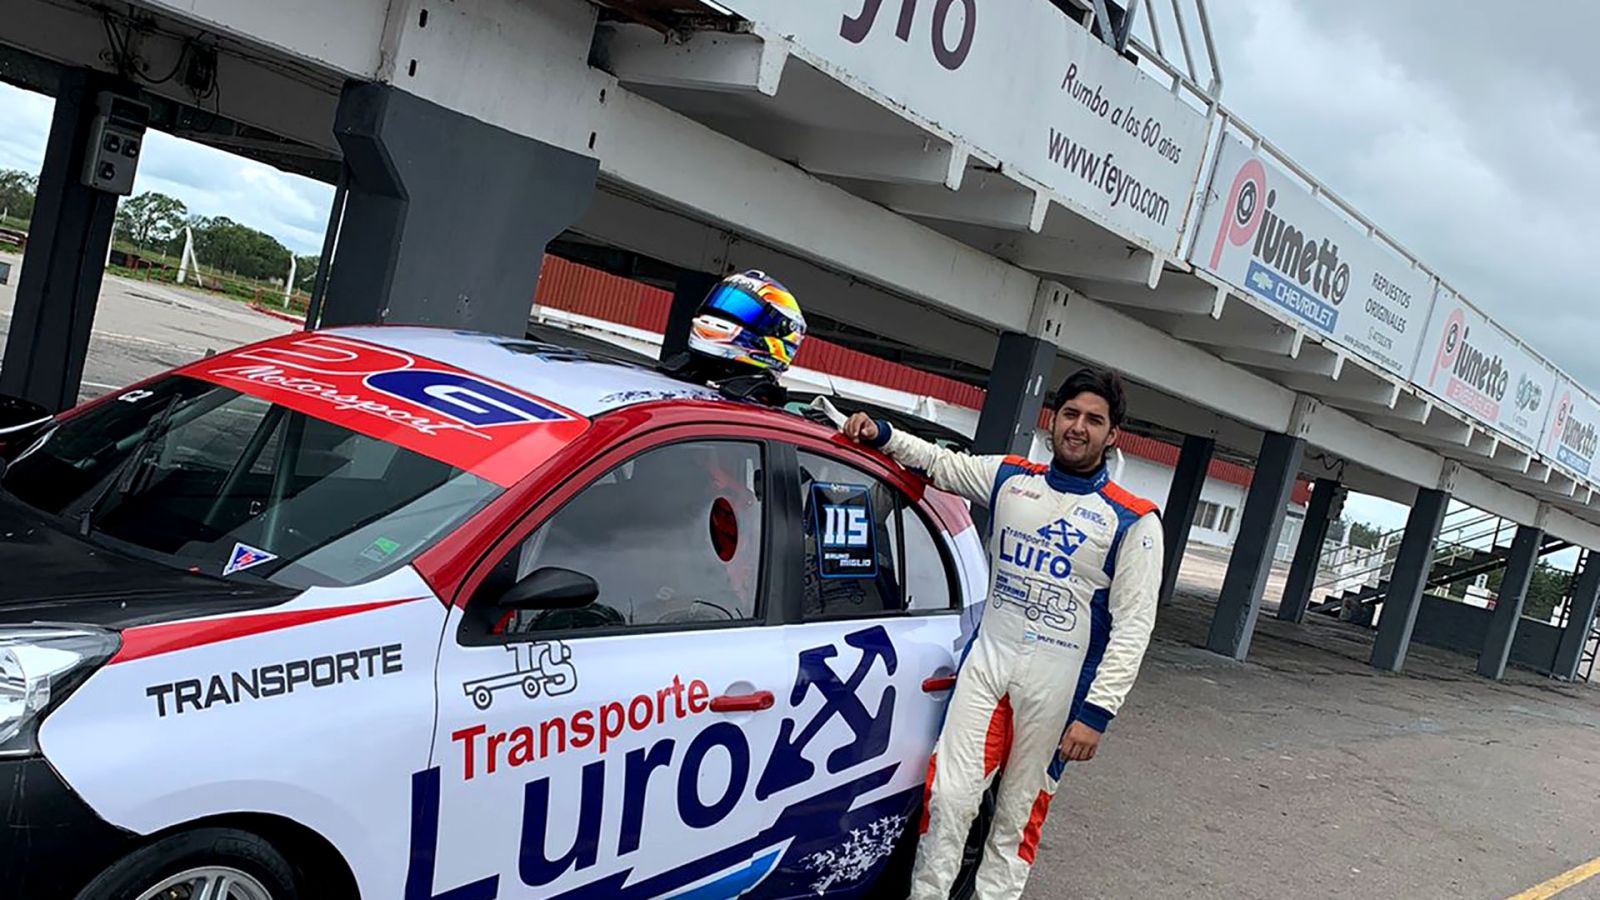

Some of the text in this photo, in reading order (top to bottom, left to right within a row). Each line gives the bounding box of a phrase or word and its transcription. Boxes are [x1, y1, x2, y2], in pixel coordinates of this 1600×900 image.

[1061, 62, 1181, 164] Rumbo a los 60 años
[1048, 127, 1169, 227] www.feyro.com
[1209, 158, 1350, 306] Piumetto
[1275, 283, 1334, 328] CHEVROLET
[1365, 298, 1407, 334] ORIGINALES
[1371, 272, 1412, 309] REPUESTOS
[1428, 307, 1509, 402] Piumetto
[209, 364, 492, 440] Motorsport
[823, 505, 868, 547] 115
[840, 559, 871, 567] MIGLIO
[999, 528, 1072, 579] Luro
[146, 643, 403, 717] TRANSPORTE
[451, 674, 709, 781] Transporte
[404, 720, 750, 900] Luro
